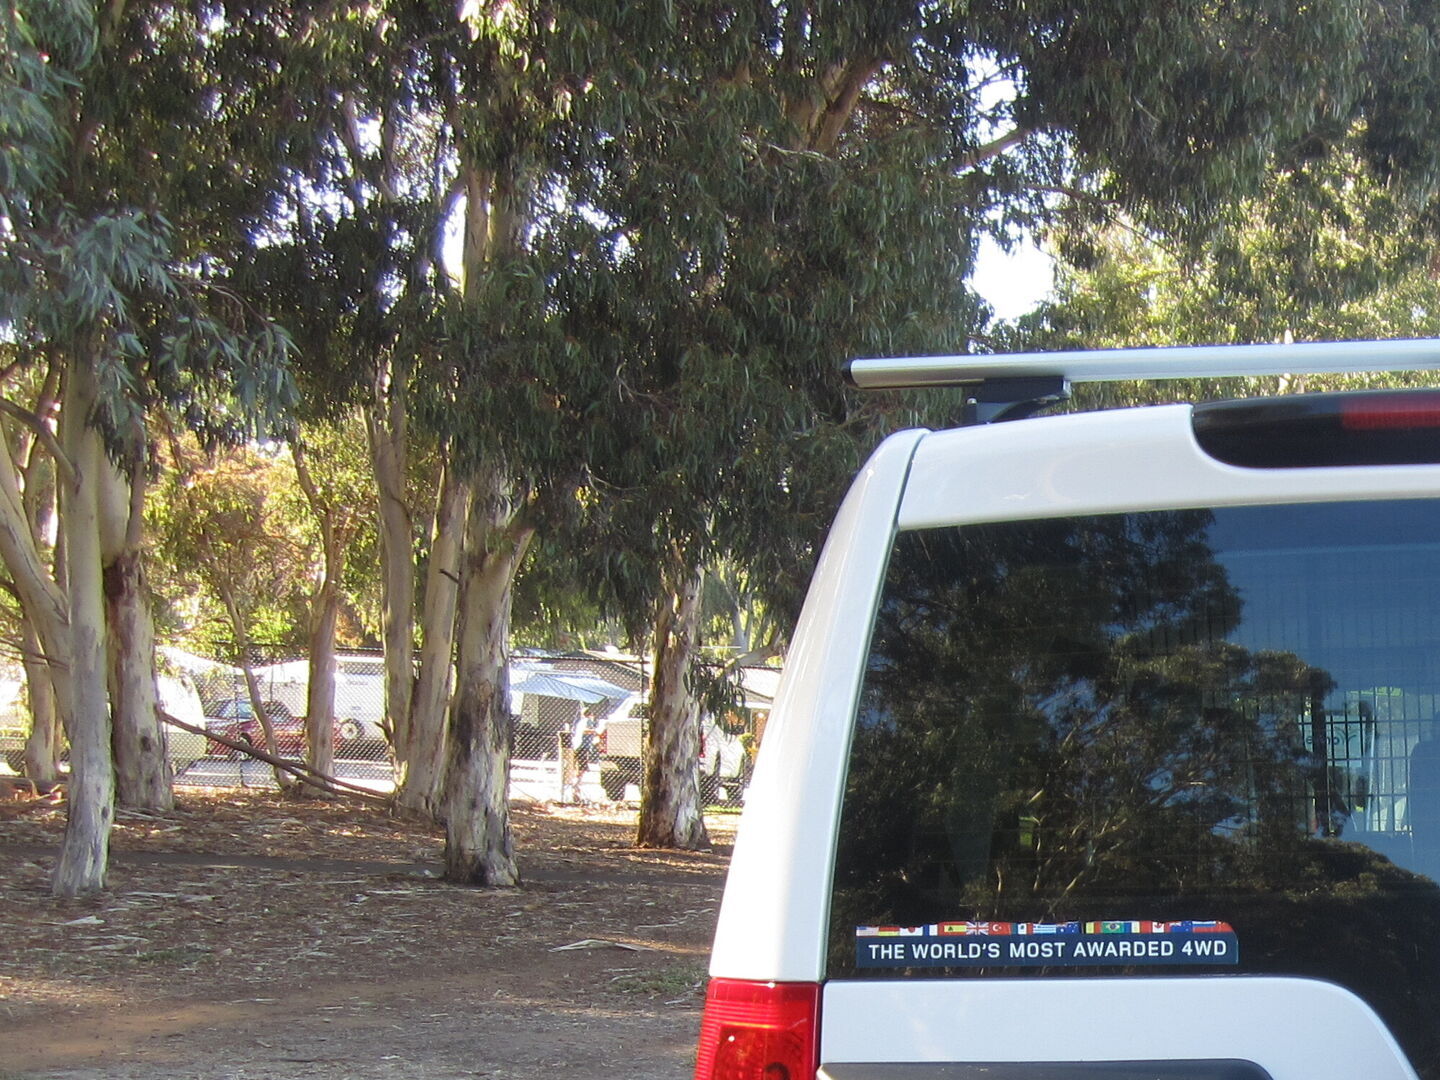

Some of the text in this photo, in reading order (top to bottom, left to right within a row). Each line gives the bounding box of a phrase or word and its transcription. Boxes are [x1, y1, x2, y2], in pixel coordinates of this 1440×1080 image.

[868, 940, 1227, 959] THE WORLD'S MOST AWARDED 4WD
